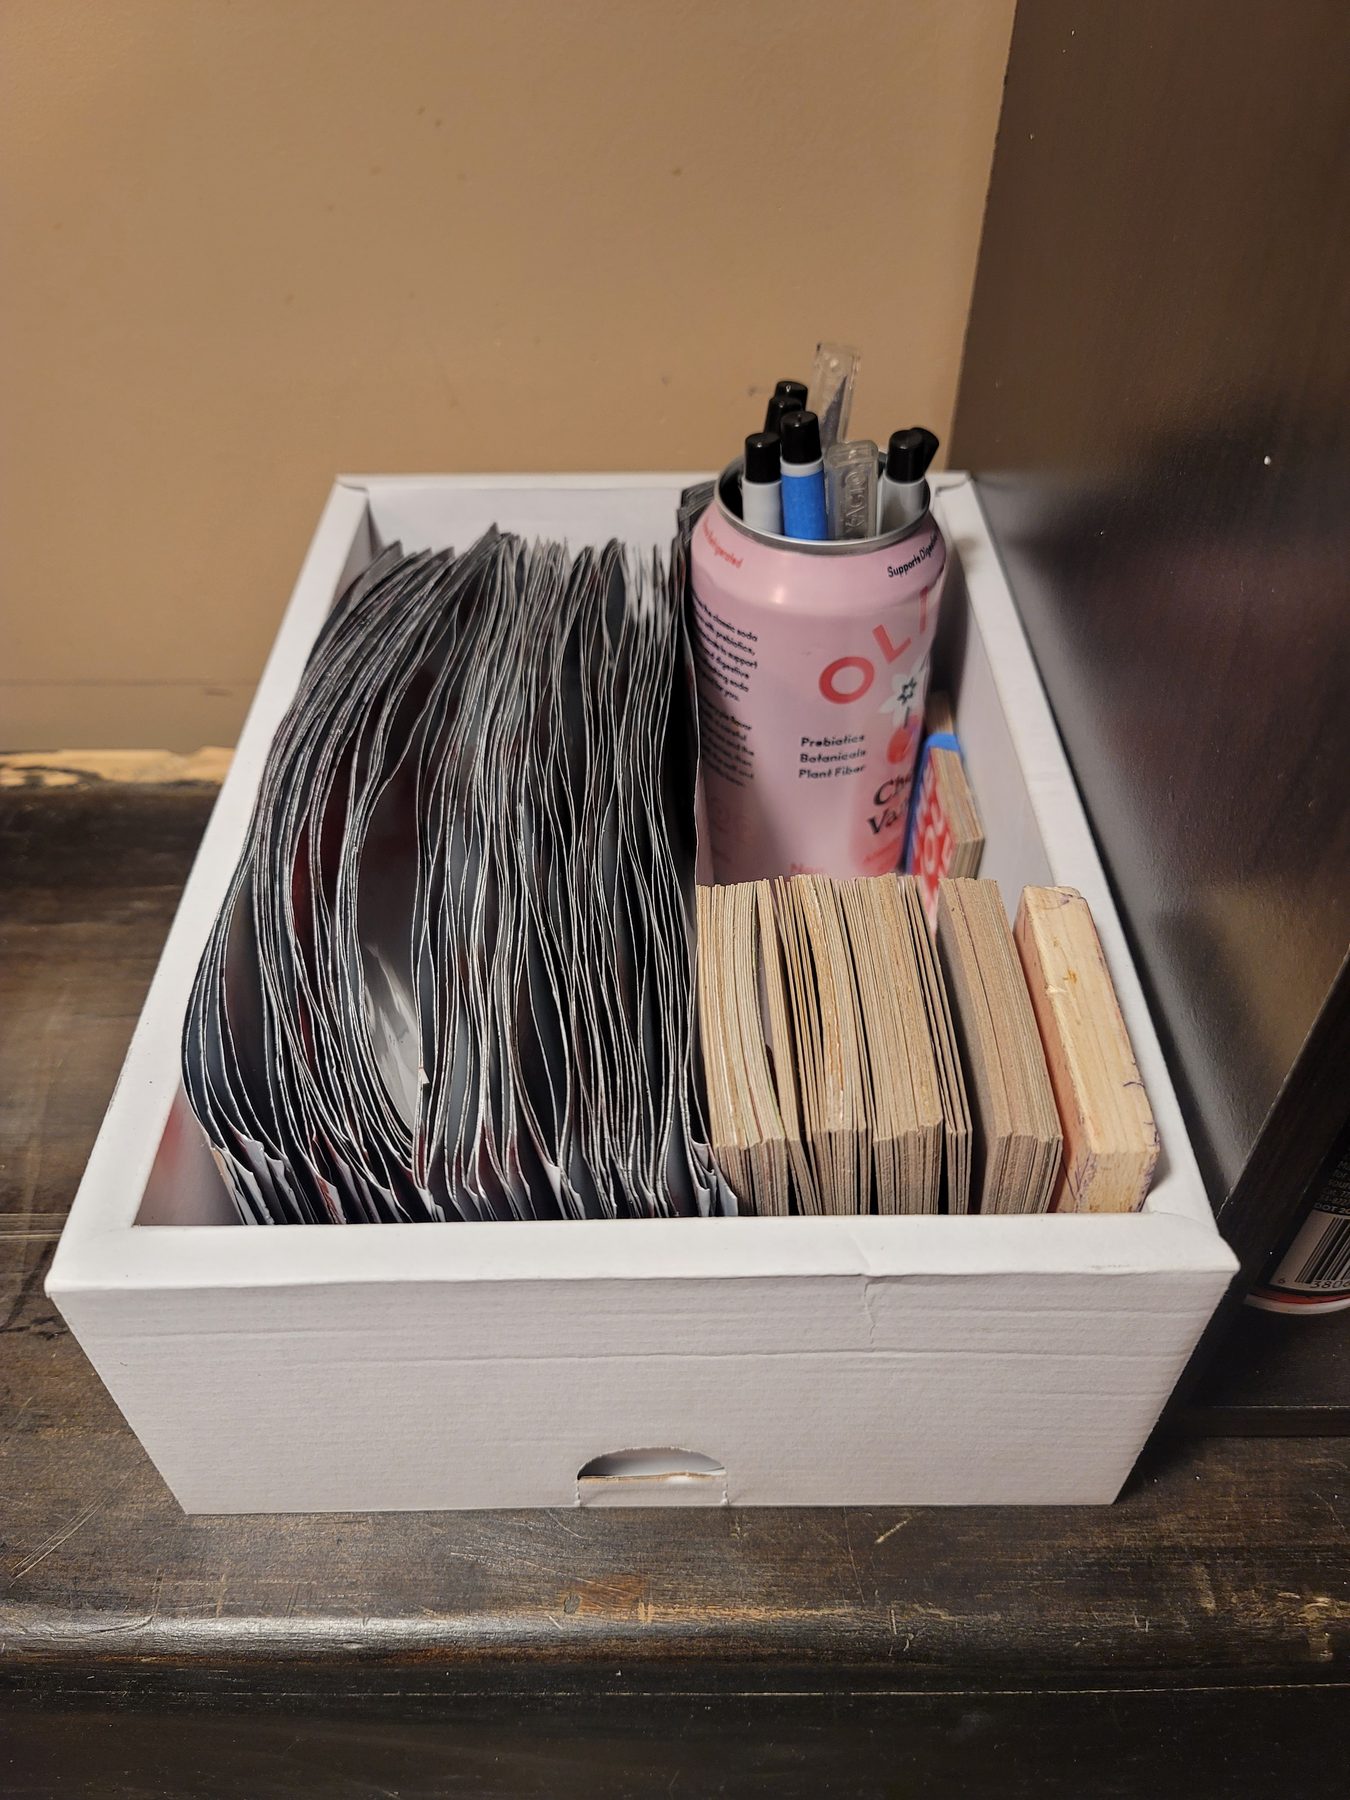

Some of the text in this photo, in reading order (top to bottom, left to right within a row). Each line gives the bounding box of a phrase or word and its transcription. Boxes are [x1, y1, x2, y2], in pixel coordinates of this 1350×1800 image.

[887, 554, 921, 578] Supports
[736, 629, 758, 643] soda
[727, 651, 758, 669] support
[729, 679, 749, 692] soda
[800, 734, 865, 747] Prebiotics
[799, 748, 867, 763] Botanicals
[798, 765, 866, 779] Plant Fiber
